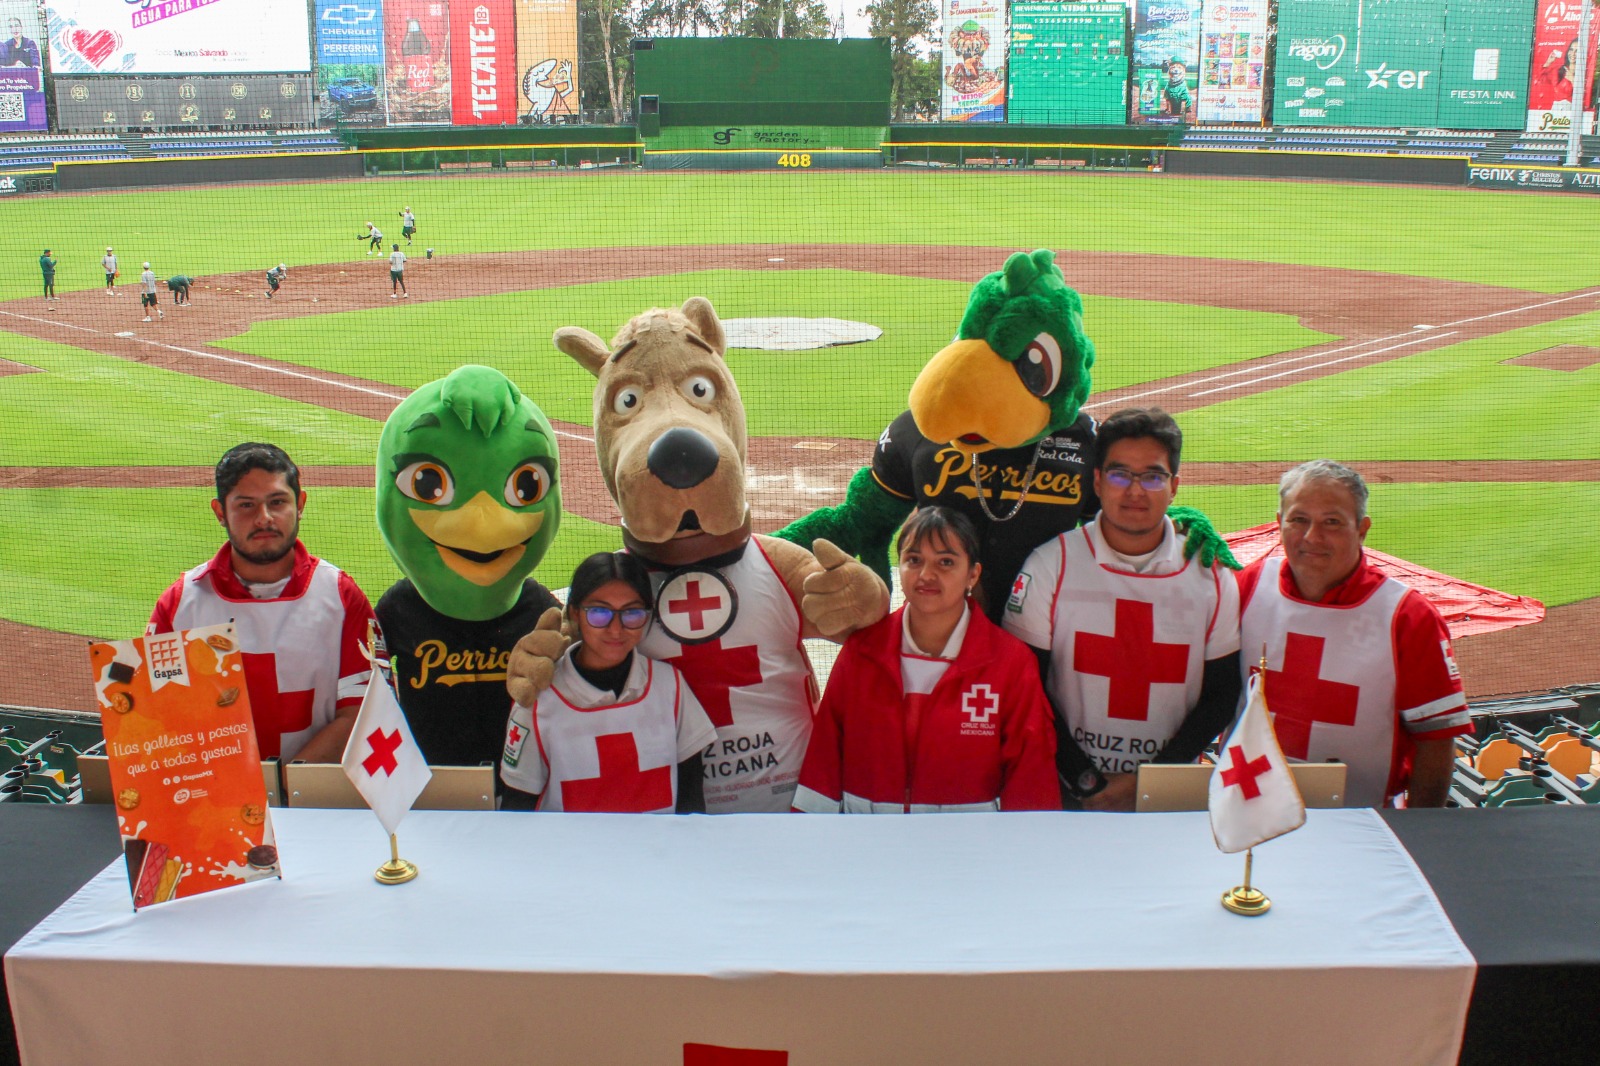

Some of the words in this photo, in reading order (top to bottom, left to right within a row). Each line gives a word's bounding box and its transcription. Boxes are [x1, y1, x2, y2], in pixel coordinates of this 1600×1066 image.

[134, 7, 161, 27] AGUA
[164, 0, 192, 17] PARA
[1061, 4, 1087, 12] NIDO
[1090, 4, 1122, 12] VERDE
[322, 28, 377, 36] CHEVROLET
[323, 44, 378, 53] PEREGRINA
[407, 62, 430, 79] Red
[470, 22, 498, 120] TECATE
[413, 79, 430, 88] Cola
[1450, 90, 1490, 99] FIESTA
[1539, 112, 1570, 130] Peric
[777, 153, 812, 168] 408
[1572, 172, 1600, 185] AZT
[1058, 451, 1085, 464] Cola
[410, 639, 512, 689] Perric
[154, 668, 183, 680] Gapsa
[143, 733, 194, 755] galletas
[197, 732, 205, 746] y
[208, 723, 249, 742] pastas
[722, 731, 775, 755] ROJA
[1075, 727, 1124, 752] CRUZ
[1129, 738, 1166, 755] ROJ
[127, 763, 148, 777] que
[151, 760, 160, 770] a
[163, 752, 197, 768] todos
[201, 739, 243, 764] gustan!
[703, 752, 779, 779] XICANA
[182, 770, 214, 781] GapsaMX
